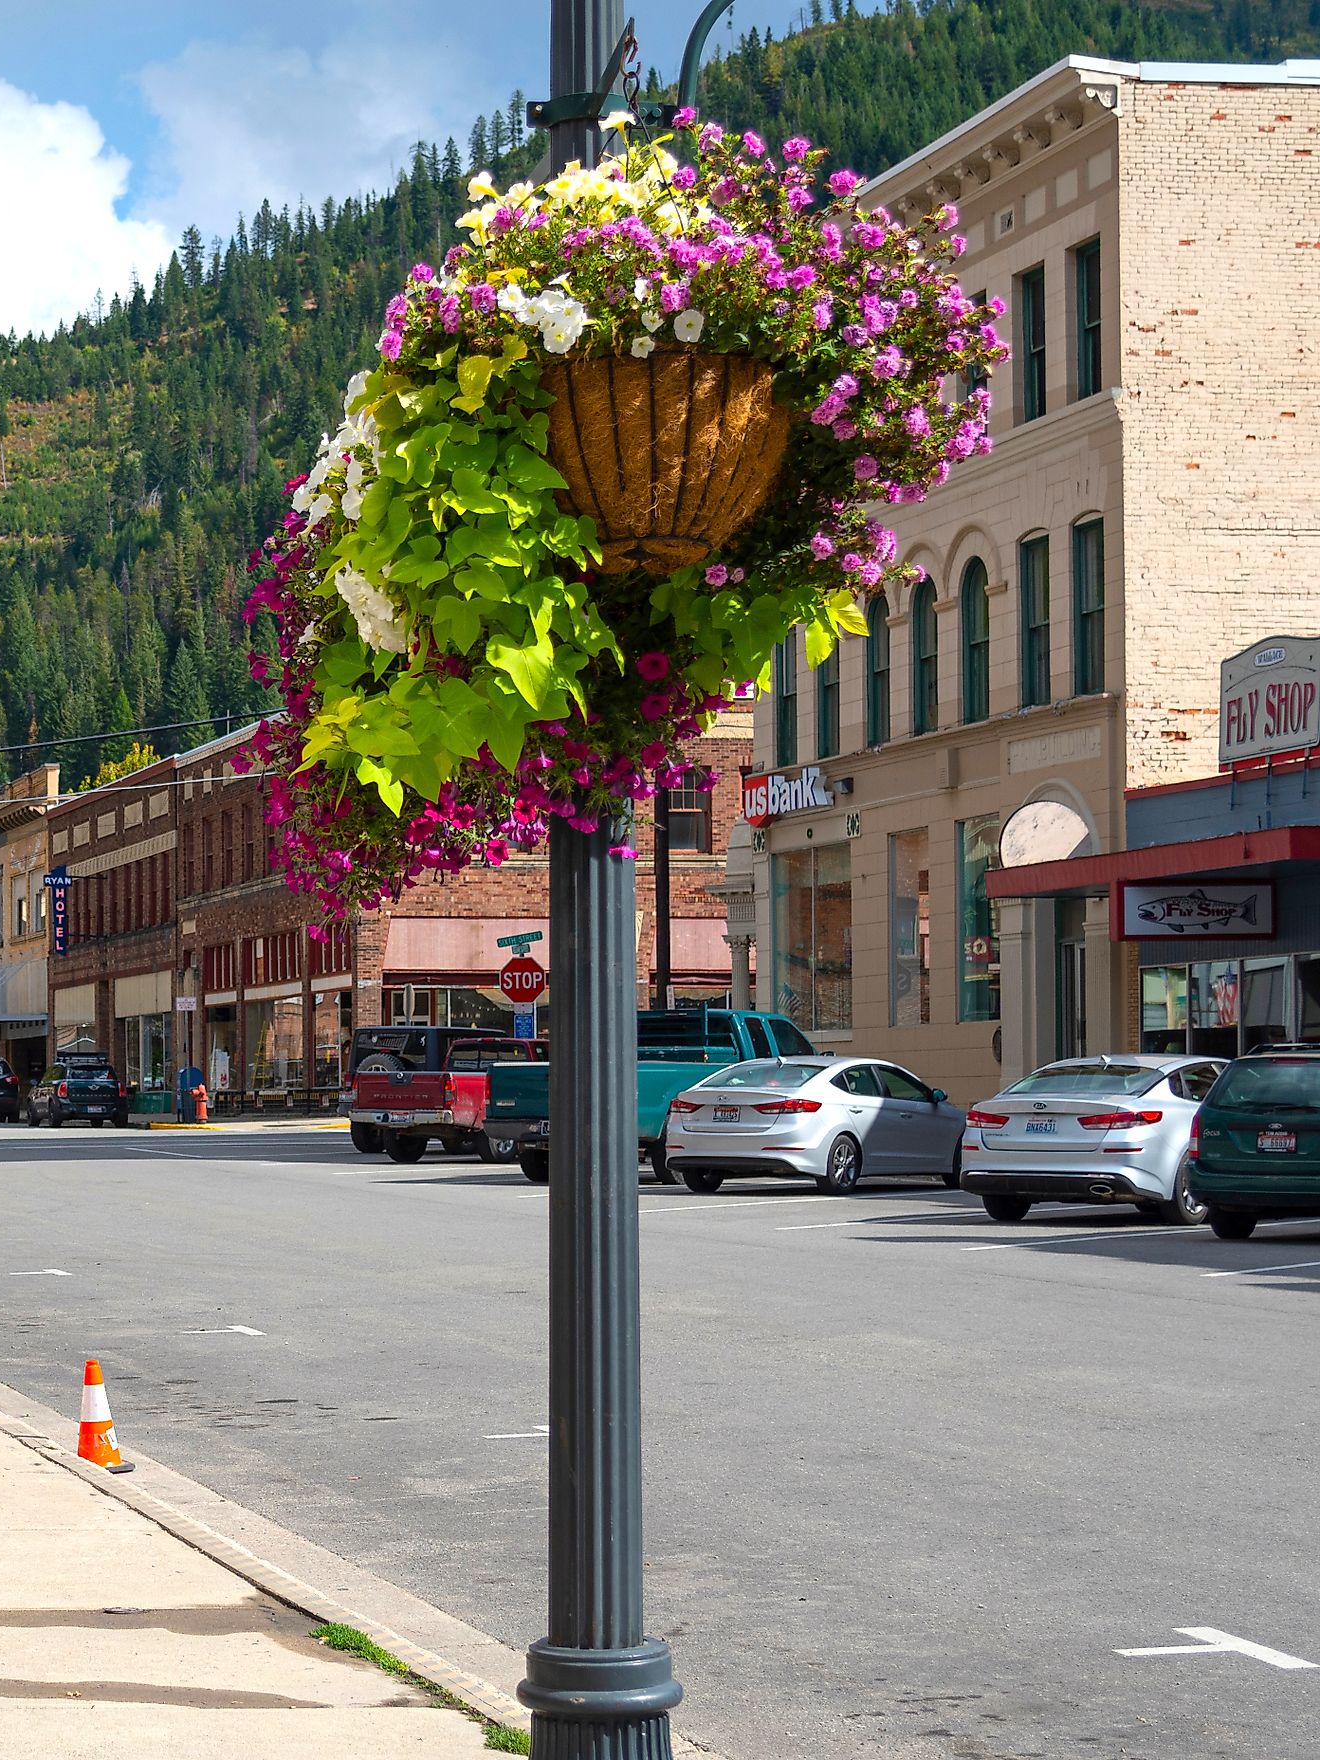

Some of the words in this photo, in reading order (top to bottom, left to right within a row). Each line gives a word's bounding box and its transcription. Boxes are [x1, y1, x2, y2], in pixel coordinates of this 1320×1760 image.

[1226, 688, 1260, 747] FLY
[1264, 681, 1316, 739] SHOP
[44, 877, 71, 885] RYAN
[55, 888, 65, 951] HOTEL
[518, 933, 541, 943] STREET
[503, 972, 542, 989] STOP
